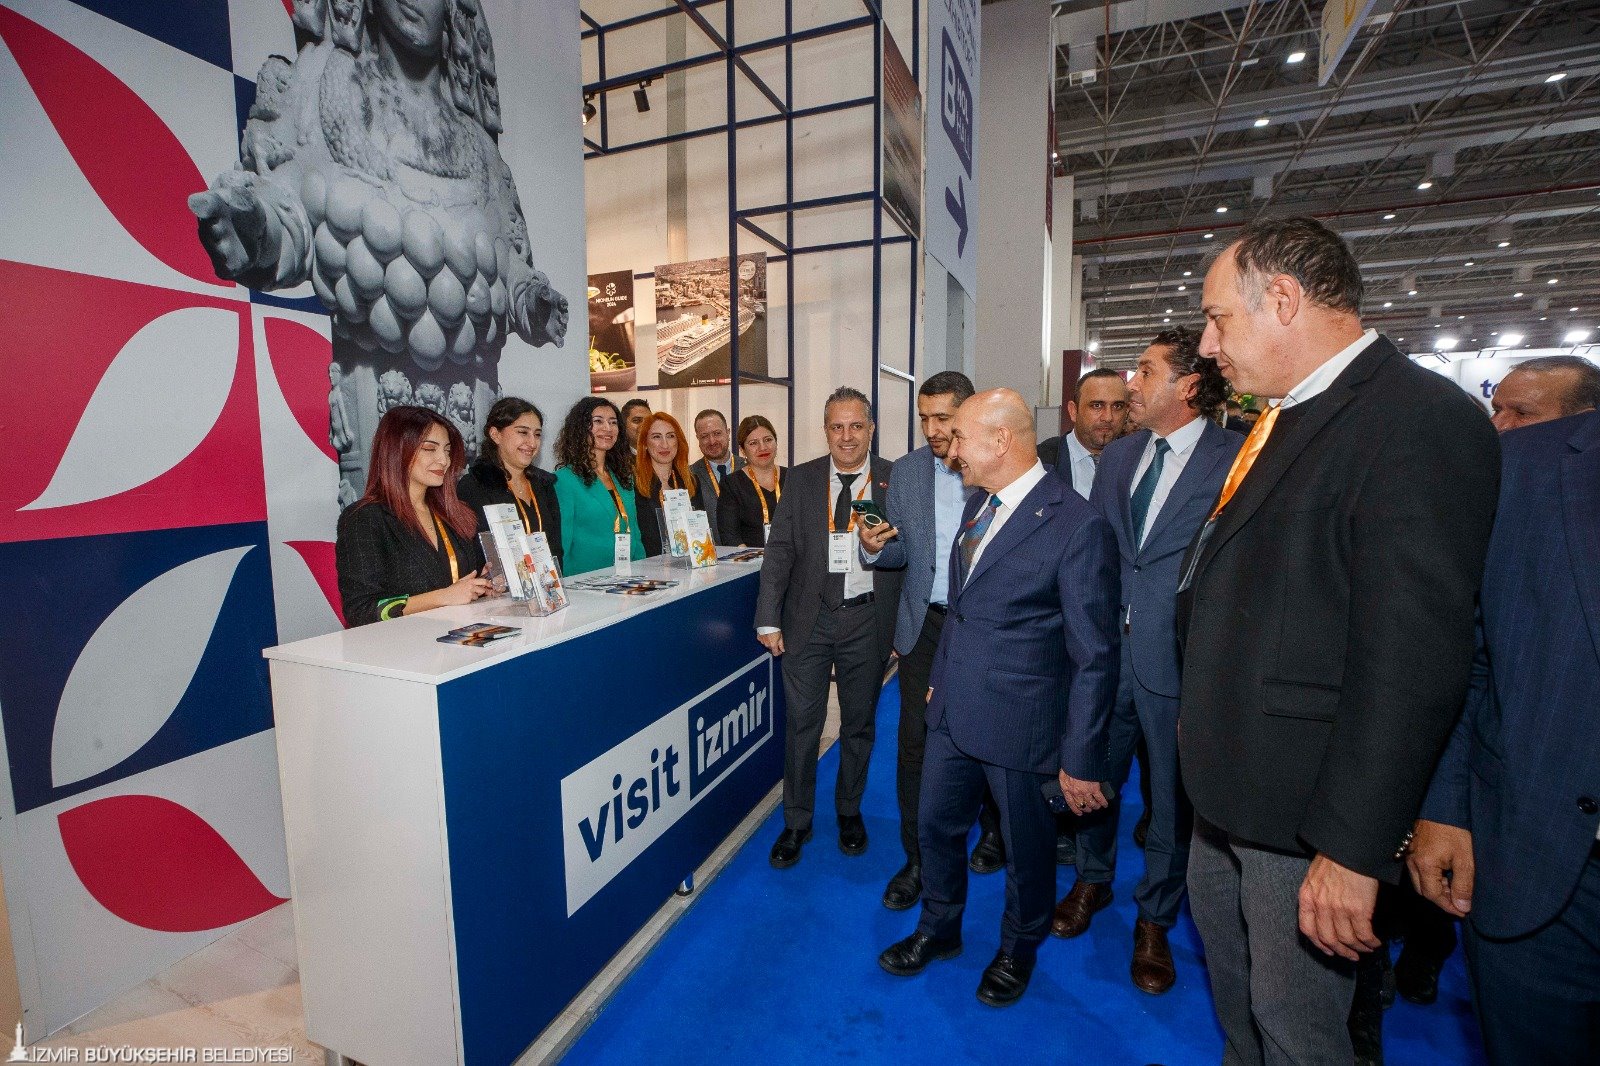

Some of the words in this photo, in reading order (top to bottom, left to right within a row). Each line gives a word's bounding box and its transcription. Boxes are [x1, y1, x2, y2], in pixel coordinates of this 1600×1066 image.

[944, 45, 956, 128] B
[578, 744, 681, 864] visit
[696, 681, 767, 777] izmir
